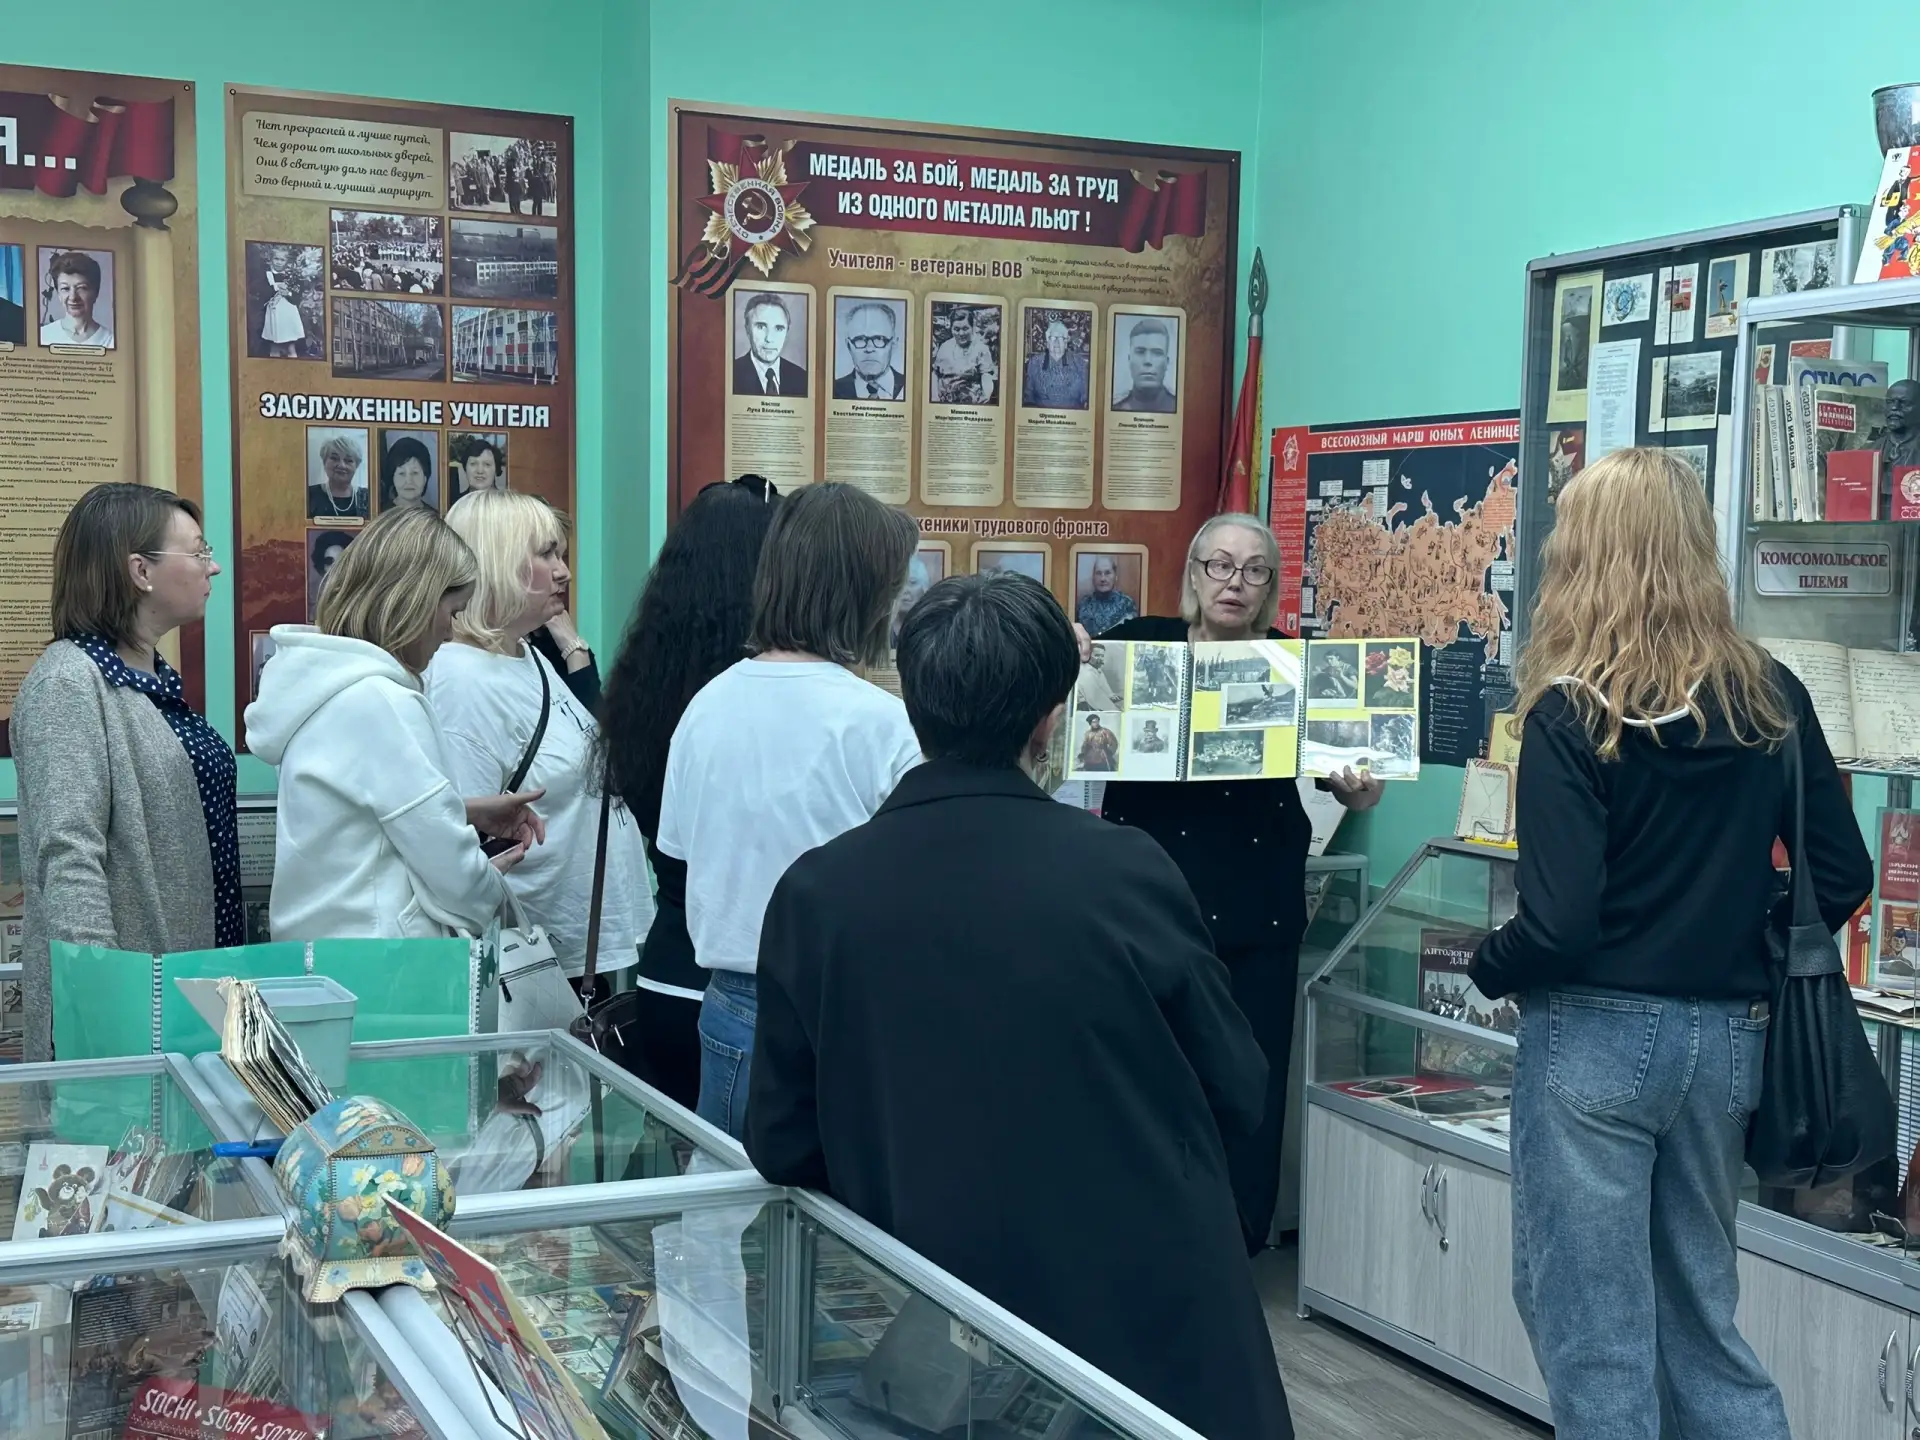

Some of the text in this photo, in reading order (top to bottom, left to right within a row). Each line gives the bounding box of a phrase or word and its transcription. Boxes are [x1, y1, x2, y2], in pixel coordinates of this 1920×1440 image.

[255, 119, 281, 131] Нет
[283, 124, 346, 138] прекрасней
[357, 131, 391, 142] лучше
[394, 134, 430, 146] путей,
[254, 137, 278, 149] Чем
[320, 145, 336, 154] от
[338, 147, 393, 159] школьных
[394, 149, 434, 165] дверей,
[256, 156, 279, 168] Они
[280, 157, 288, 168] в
[290, 158, 340, 176] светлую
[341, 165, 367, 177] даль
[370, 168, 388, 177] нас
[391, 166, 425, 182] ведут
[809, 153, 1119, 203] МЕДАЛЬ ЗА БОЙ, МЕДАЛЬ ЗА ТРУД
[254, 173, 434, 201] Это верный и лучший маршрут.
[838, 192, 863, 215] ИЗ
[868, 194, 938, 222] ОДНОГО
[943, 200, 1026, 226] МЕТАЛЛА
[1029, 205, 1080, 232] ЛЬЮТ
[828, 249, 895, 272] Учителя
[910, 257, 987, 279] ветераны
[990, 260, 1023, 279] ВОВ
[259, 392, 550, 429] ЗАСЛУЖЕННЫЕ УЧИТЕЛЯ
[1767, 397, 1776, 419] СССР
[1321, 423, 1520, 449] ВСЕСОЮЗНЫЙ МАРШ ЮНЫХ ЛЕНИНЦЕ
[1769, 419, 1779, 452] ИСТОРИЯ
[1785, 400, 1796, 469] ИСТОРИЯ СССР
[1801, 390, 1815, 471] ИСТОРИЯ СССР
[974, 518, 1050, 538] трудового
[1054, 516, 1109, 539] фронта
[1760, 551, 1888, 568] КОМСОМОЛЬСКОЕ
[1798, 575, 1849, 589] ПЛЕМЯ
[1424, 947, 1474, 958] АНТОЛОГИ
[139, 1388, 197, 1421] SOCHI
[202, 1405, 255, 1435] SOCHI
